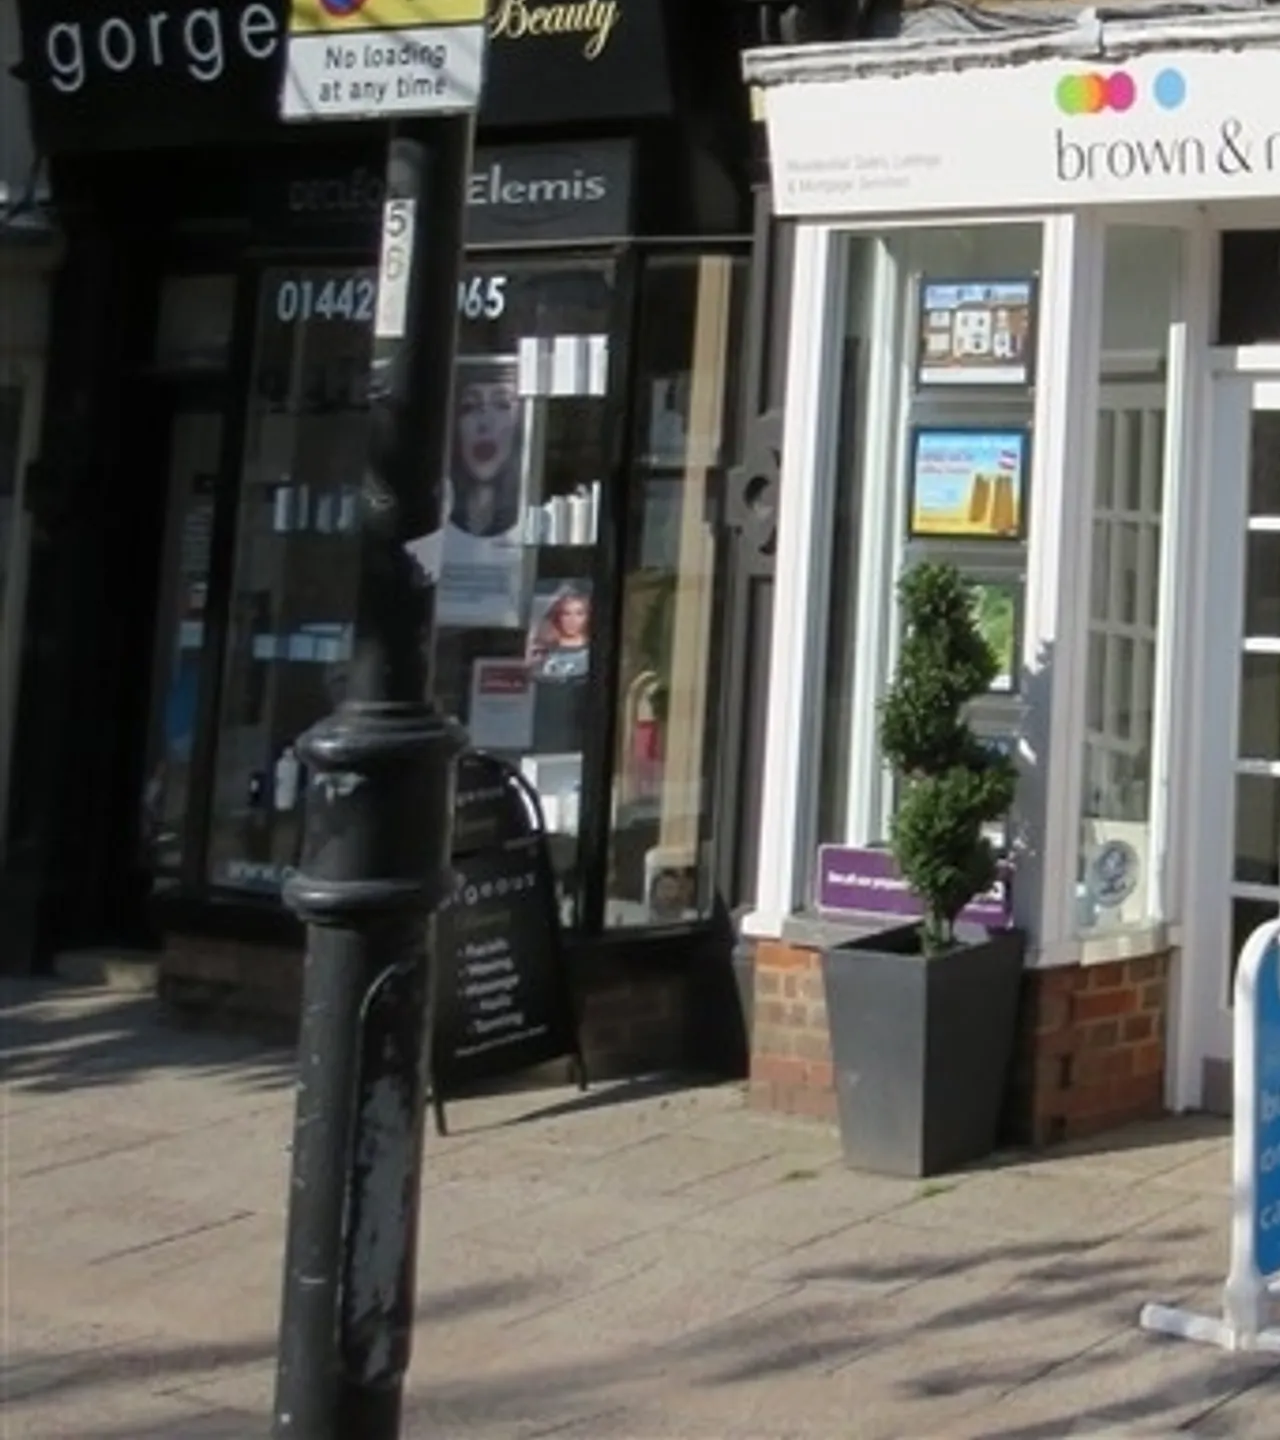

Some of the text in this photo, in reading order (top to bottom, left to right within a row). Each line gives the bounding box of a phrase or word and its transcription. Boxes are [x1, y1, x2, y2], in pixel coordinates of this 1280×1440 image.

[325, 43, 448, 70] No loading
[318, 75, 448, 104] at any time
[1055, 127, 1206, 182] brown
[1217, 119, 1254, 176] &
[464, 164, 607, 206] Elemis
[276, 279, 375, 322] 01442
